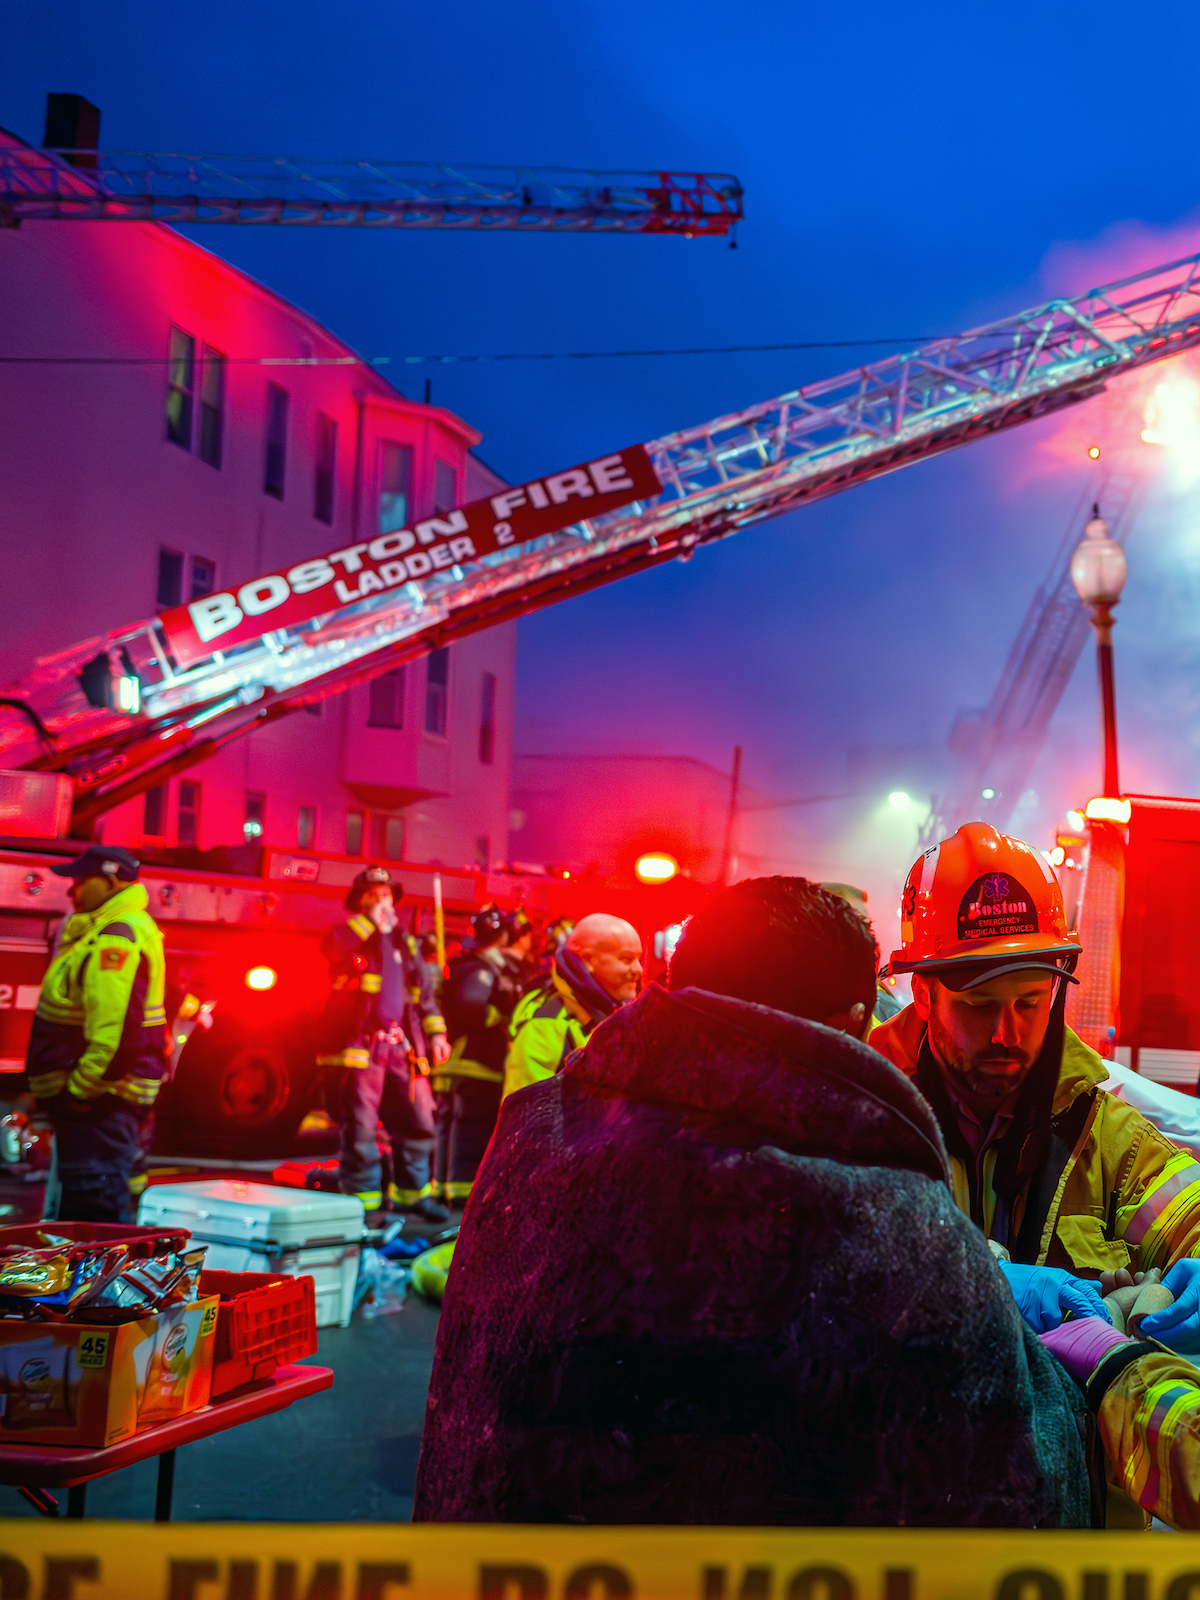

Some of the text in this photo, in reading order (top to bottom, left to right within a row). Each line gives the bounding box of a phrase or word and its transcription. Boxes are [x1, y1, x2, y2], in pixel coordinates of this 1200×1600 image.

[189, 454, 634, 642] BOSTON FIRE
[334, 523, 515, 604] LADDER 2
[969, 900, 1027, 916] Boston
[979, 917, 1021, 927] EMERGENCY
[964, 924, 1035, 938] MEDICAL SERVICES
[205, 1306, 216, 1322] 45
[81, 1337, 106, 1354] 45
